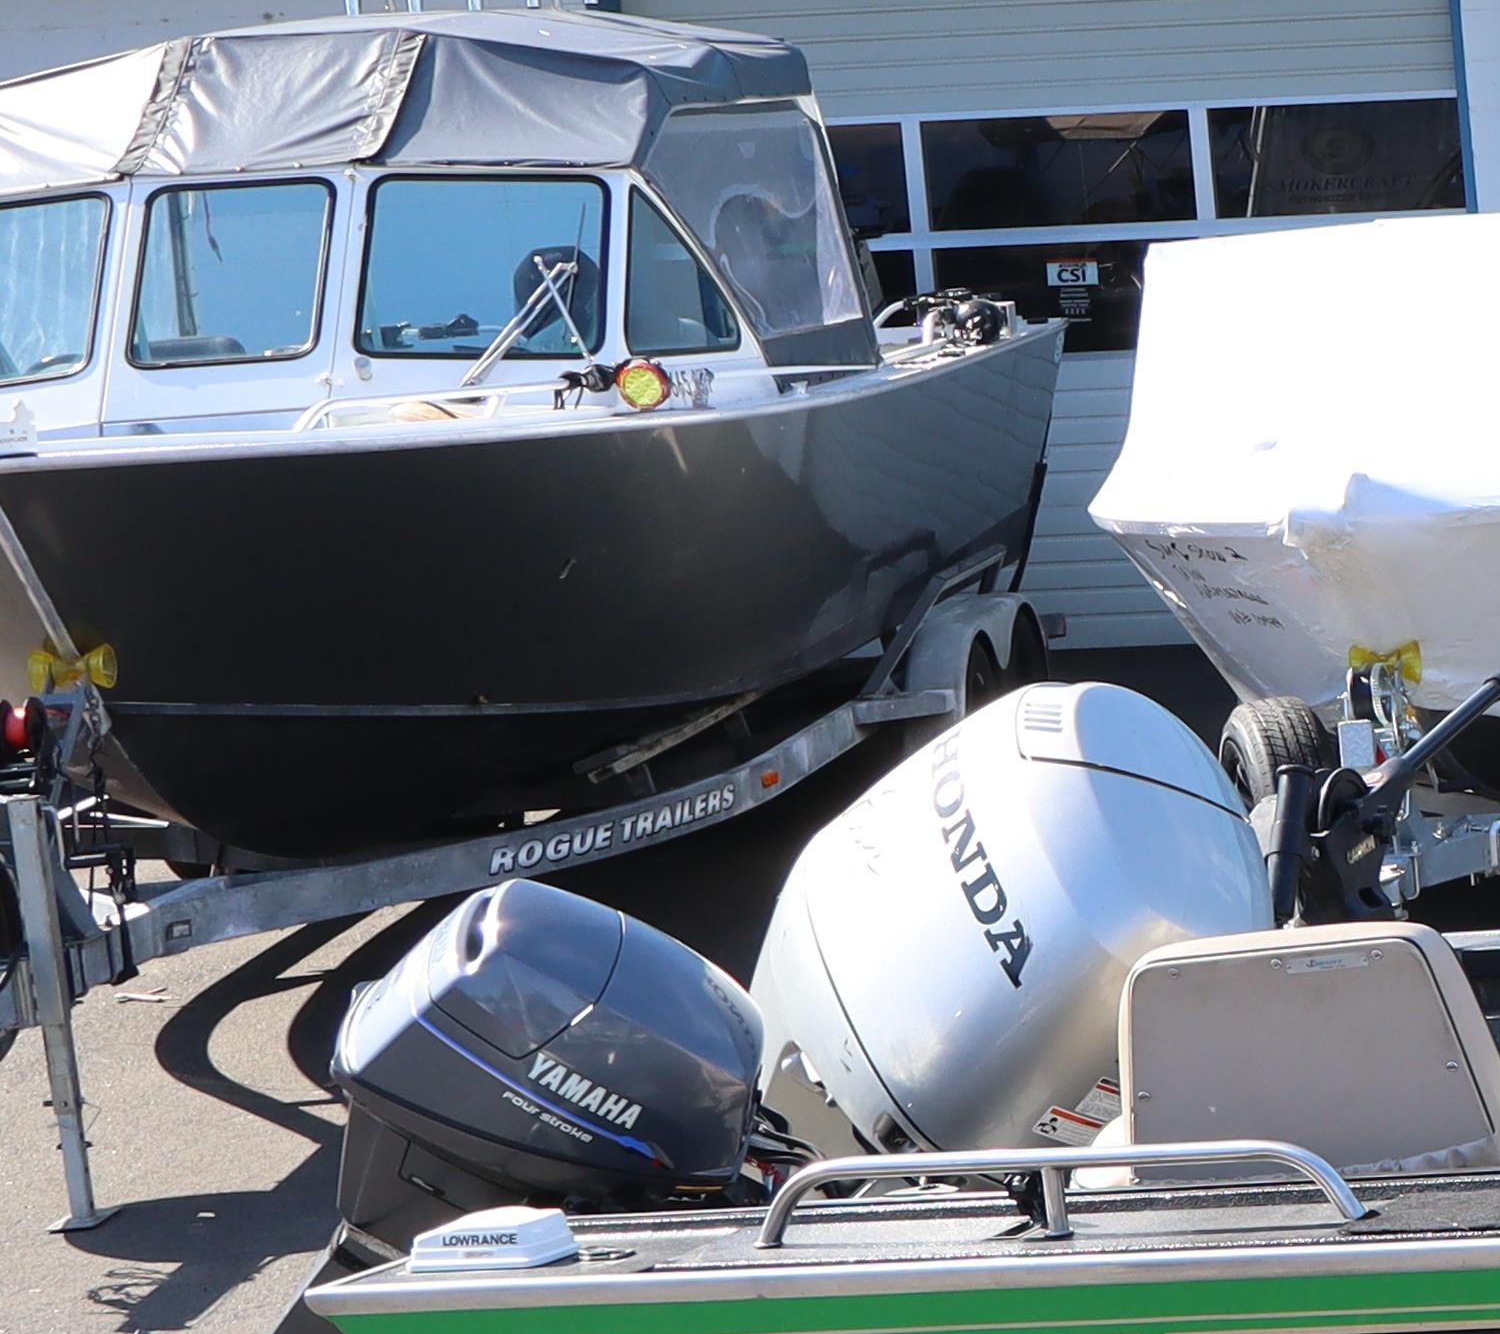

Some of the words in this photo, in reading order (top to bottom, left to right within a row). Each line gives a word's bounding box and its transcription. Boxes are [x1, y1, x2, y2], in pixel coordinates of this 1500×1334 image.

[1057, 268, 1087, 283] CSI
[488, 822, 615, 876] ROGUE
[620, 783, 736, 844] TRAILERS
[931, 728, 1033, 990] HONDA
[526, 1052, 643, 1131] YAMAHA
[442, 1233, 518, 1247] LOWRANCE
